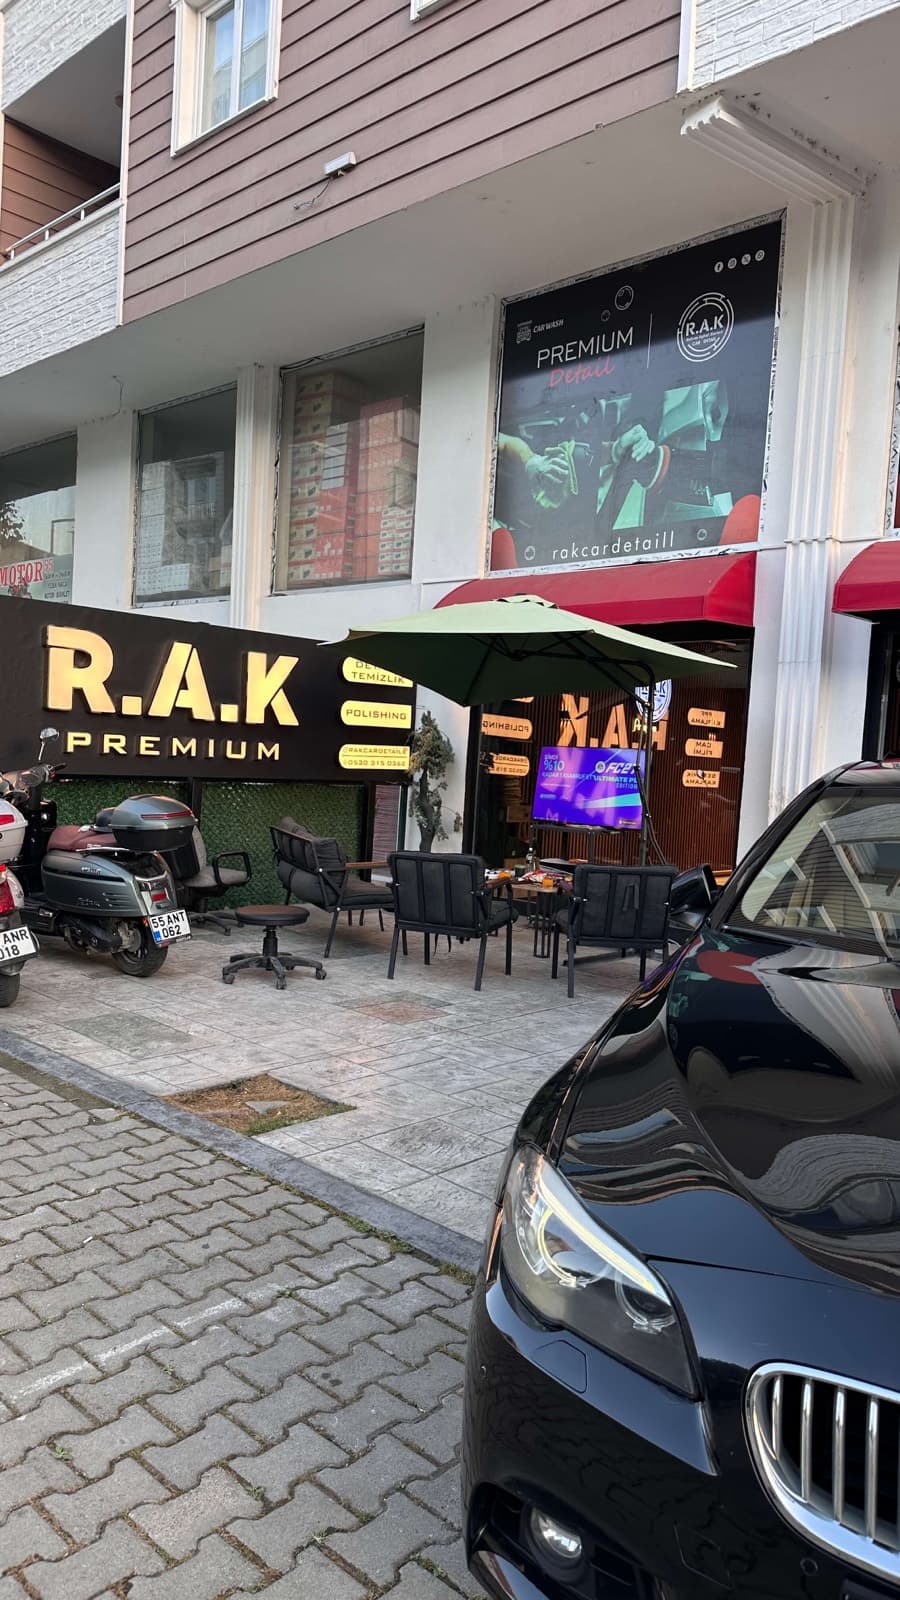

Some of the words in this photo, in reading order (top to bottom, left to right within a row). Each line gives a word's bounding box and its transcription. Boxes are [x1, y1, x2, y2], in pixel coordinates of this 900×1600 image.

[533, 323, 545, 333] CAR
[546, 319, 564, 330] WASH
[686, 314, 724, 336] R.A.K
[536, 326, 634, 368] PREMIUM
[548, 354, 616, 388] Detail
[552, 530, 674, 560] rakcardetaill
[0, 560, 43, 586] MOTOR
[45, 624, 299, 726] R.A.K
[346, 708, 407, 720] POLISHING
[66, 731, 280, 760] PREMIUM
[544, 760, 566, 771] %10
[152, 918, 166, 928] 55
[168, 912, 186, 924] ANT
[3, 929, 28, 944] ANR
[162, 925, 182, 938] 062
